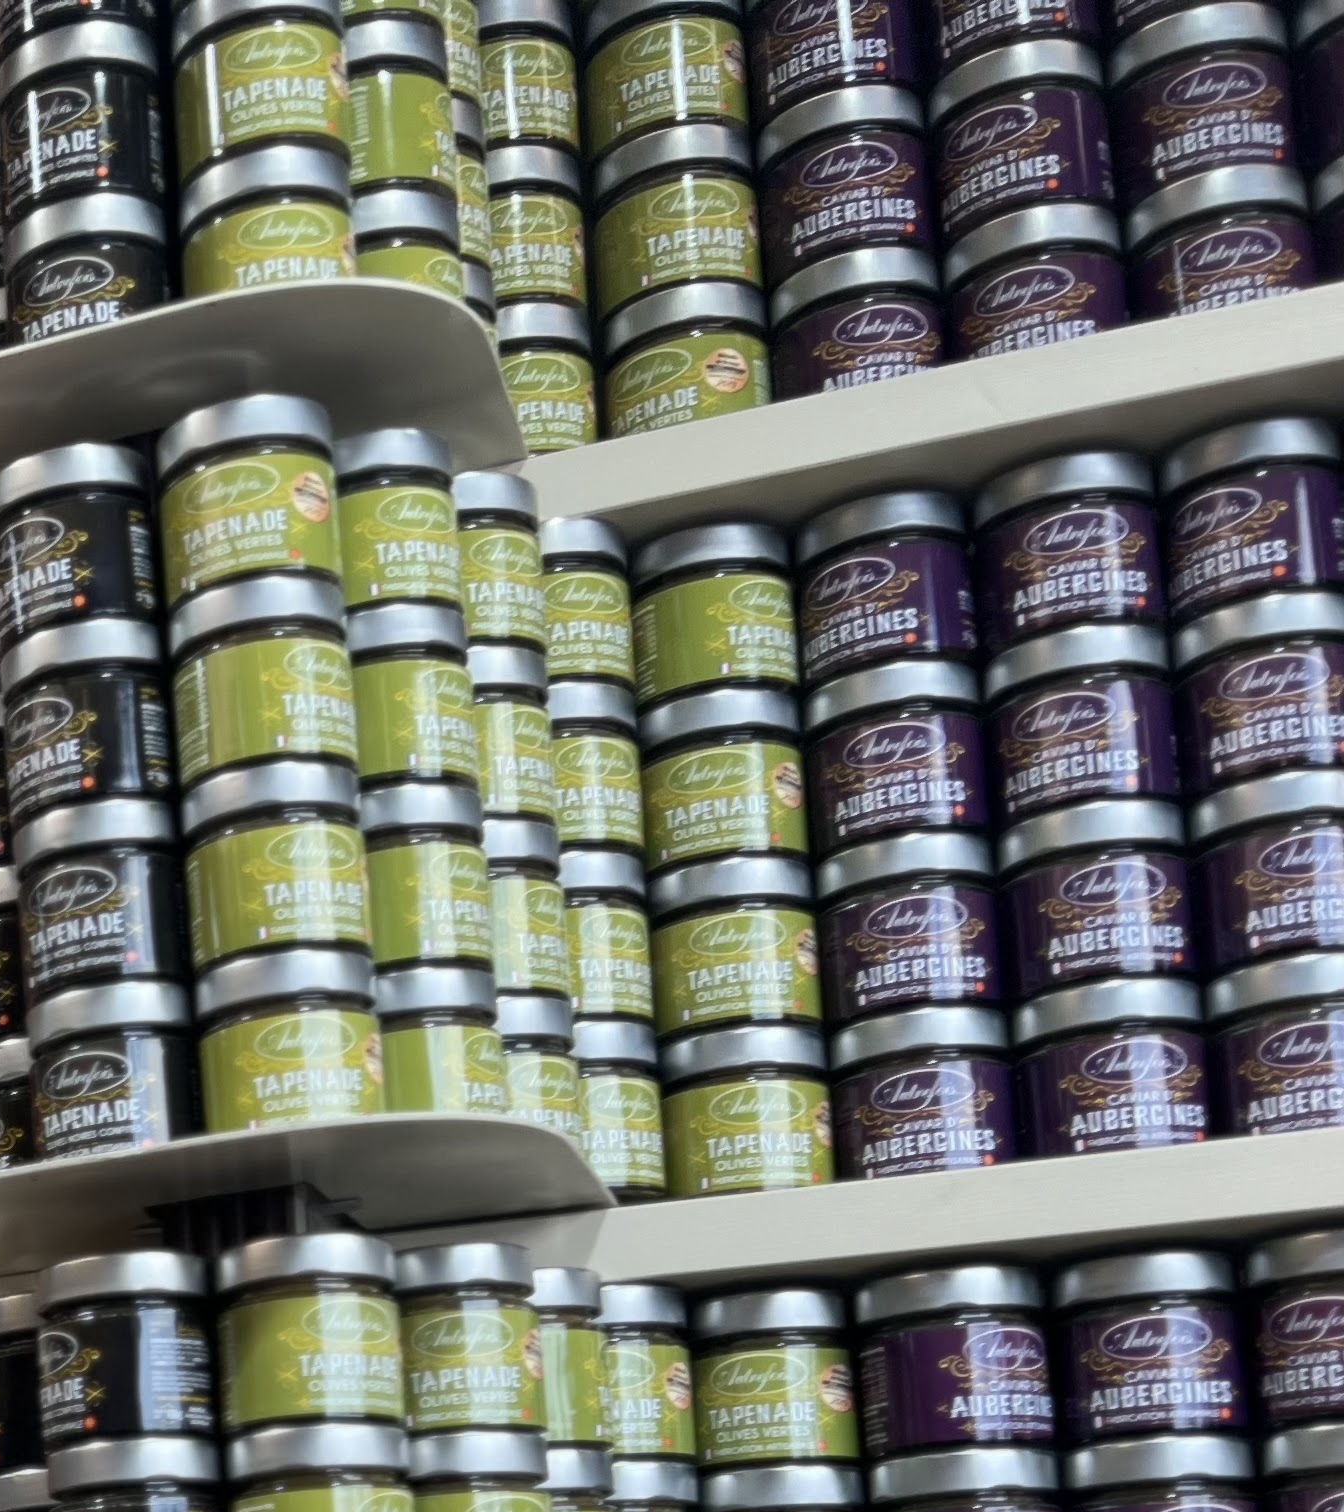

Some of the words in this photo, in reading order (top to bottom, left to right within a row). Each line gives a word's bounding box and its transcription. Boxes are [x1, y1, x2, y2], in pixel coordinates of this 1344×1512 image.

[222, 75, 327, 108] TAPENADE
[620, 61, 721, 98] TAPENADE
[229, 103, 272, 121] OLIVES
[278, 98, 324, 117] VERTES
[627, 93, 677, 114] OLIVES
[1186, 112, 1227, 130] CAVIAR
[1152, 123, 1283, 163] AUBERGINES
[820, 189, 862, 211] CAVIAR
[791, 198, 915, 241] AUBERGINES
[648, 227, 746, 252] TAPENADE
[655, 248, 696, 267] OLIVES
[700, 245, 742, 265] VERTES
[235, 258, 340, 287] TAPENADE
[183, 509, 288, 550] TAPENADE
[1046, 559, 1092, 579] CAVIAR
[1014, 571, 1148, 612] AUBERGINES
[865, 769, 910, 787] CAVIAR
[1006, 750, 1138, 798] AUBERGINES
[835, 780, 966, 821] AUBERGINES
[665, 795, 769, 834] TAPENADE
[674, 819, 715, 839] OLIVES
[720, 815, 765, 834] VERTES
[265, 884, 362, 905] TAPENADE
[29, 914, 125, 953] TAPENADE
[1048, 925, 1184, 961] AUBERGINES
[887, 944, 934, 962] CAVIAR
[686, 961, 793, 990] TAPENADE
[855, 957, 986, 990] AUBERGINES
[694, 983, 739, 1001] OLIVES
[744, 980, 790, 998] VERTES
[253, 1070, 362, 1098] TAPENADE
[42, 1100, 139, 1137] TAPENADE
[892, 1118, 939, 1135] CAVIAR
[1071, 1104, 1206, 1137] AUBERGINES
[707, 1135, 812, 1159] TAPENADE
[862, 1128, 996, 1165] AUBERGINES
[714, 1156, 758, 1172] OLIVES
[764, 1154, 809, 1169] VERTES
[299, 1355, 398, 1378] TAPENADE
[411, 1367, 521, 1391] TAPENADE
[1124, 1368, 1176, 1383] CAVIAR
[419, 1391, 465, 1407] OLIVES
[470, 1388, 517, 1404] VERTES
[1089, 1380, 1233, 1410] AUBERGINES
[709, 1400, 815, 1428] TAPENADE
[715, 1426, 757, 1443] OLIVES
[762, 1424, 809, 1441] VERTES
